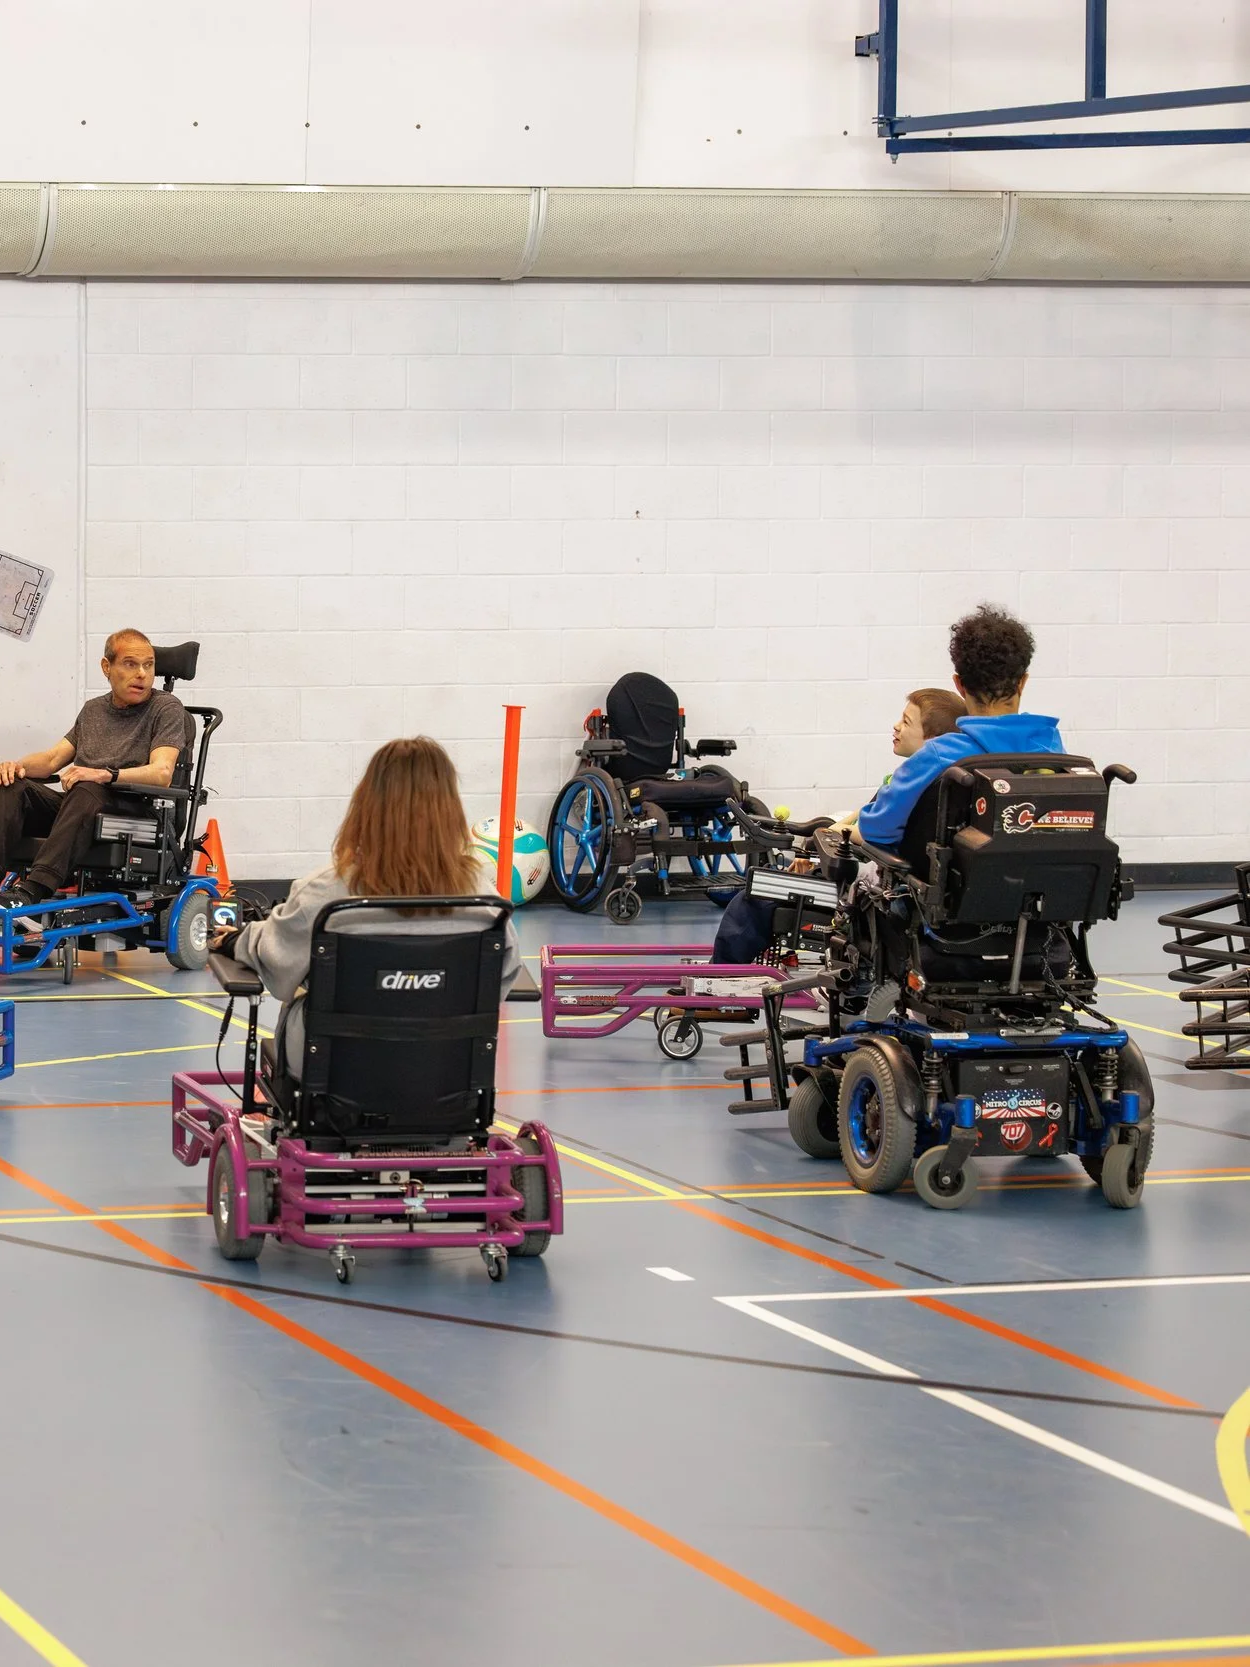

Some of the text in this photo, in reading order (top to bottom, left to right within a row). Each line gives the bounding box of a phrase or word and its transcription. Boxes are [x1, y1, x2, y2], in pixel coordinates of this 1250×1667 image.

[29, 592, 41, 616] SOCCER
[1052, 815, 1094, 824] BELIEVE!
[381, 970, 441, 990] drive
[985, 1099, 1042, 1108] NITRO CIRCUS
[1002, 1122, 1025, 1139] 707
